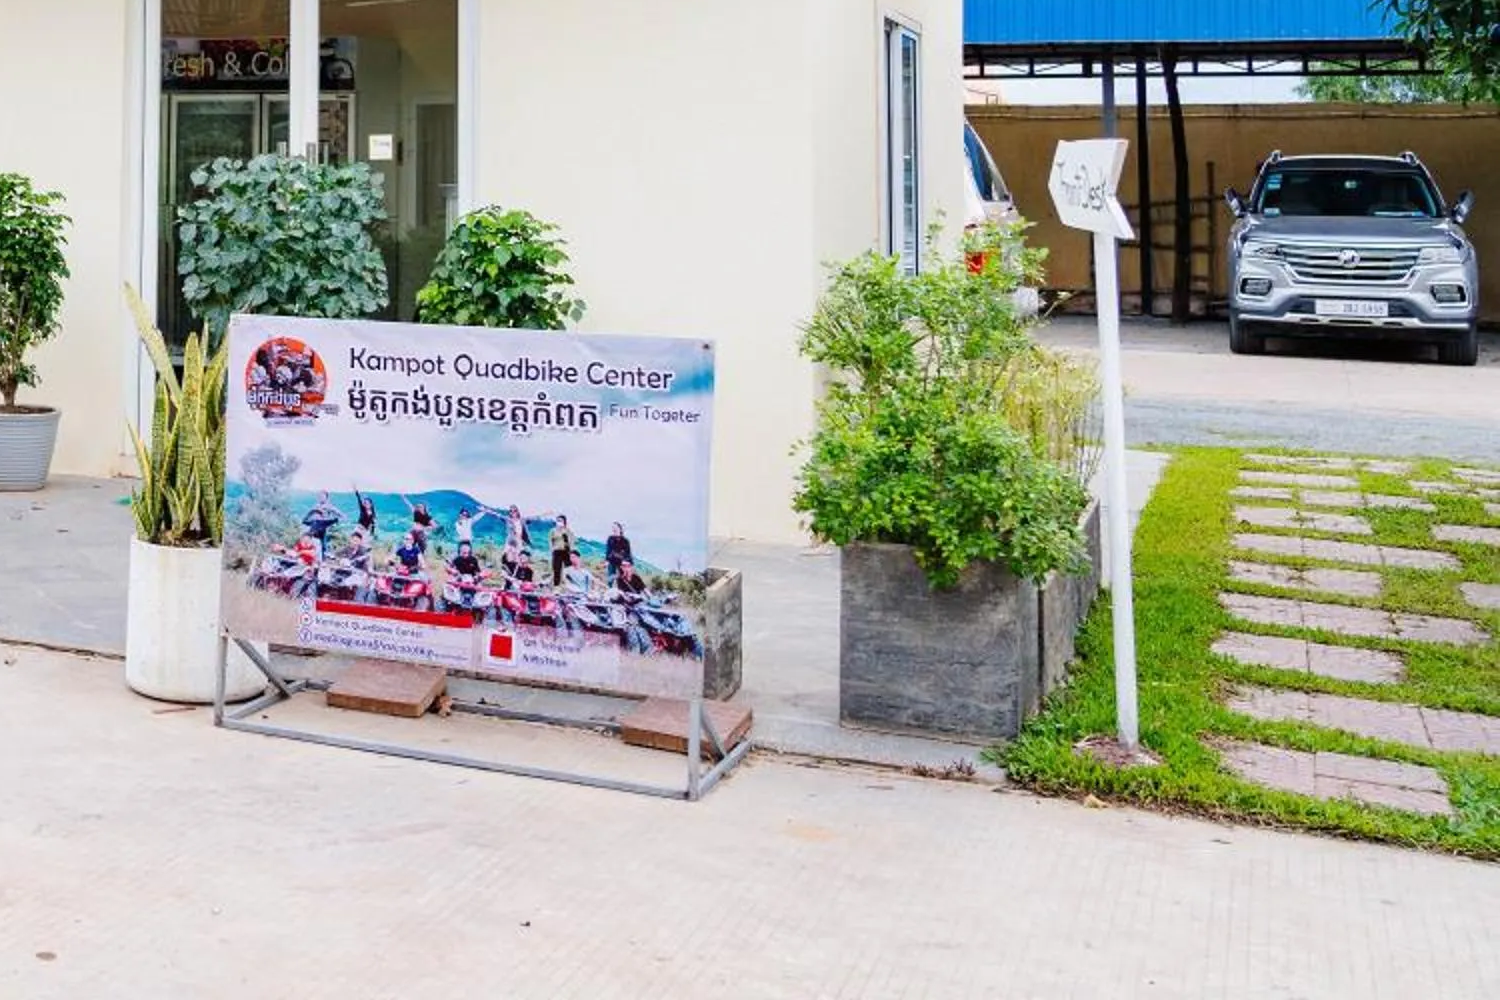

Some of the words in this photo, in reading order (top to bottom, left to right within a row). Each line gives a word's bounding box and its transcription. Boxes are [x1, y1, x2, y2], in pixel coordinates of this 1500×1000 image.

[223, 50, 242, 77] &
[349, 347, 445, 376] Kampot
[454, 353, 579, 384] Quadbike
[587, 362, 673, 389] Center
[609, 402, 639, 418] Fun
